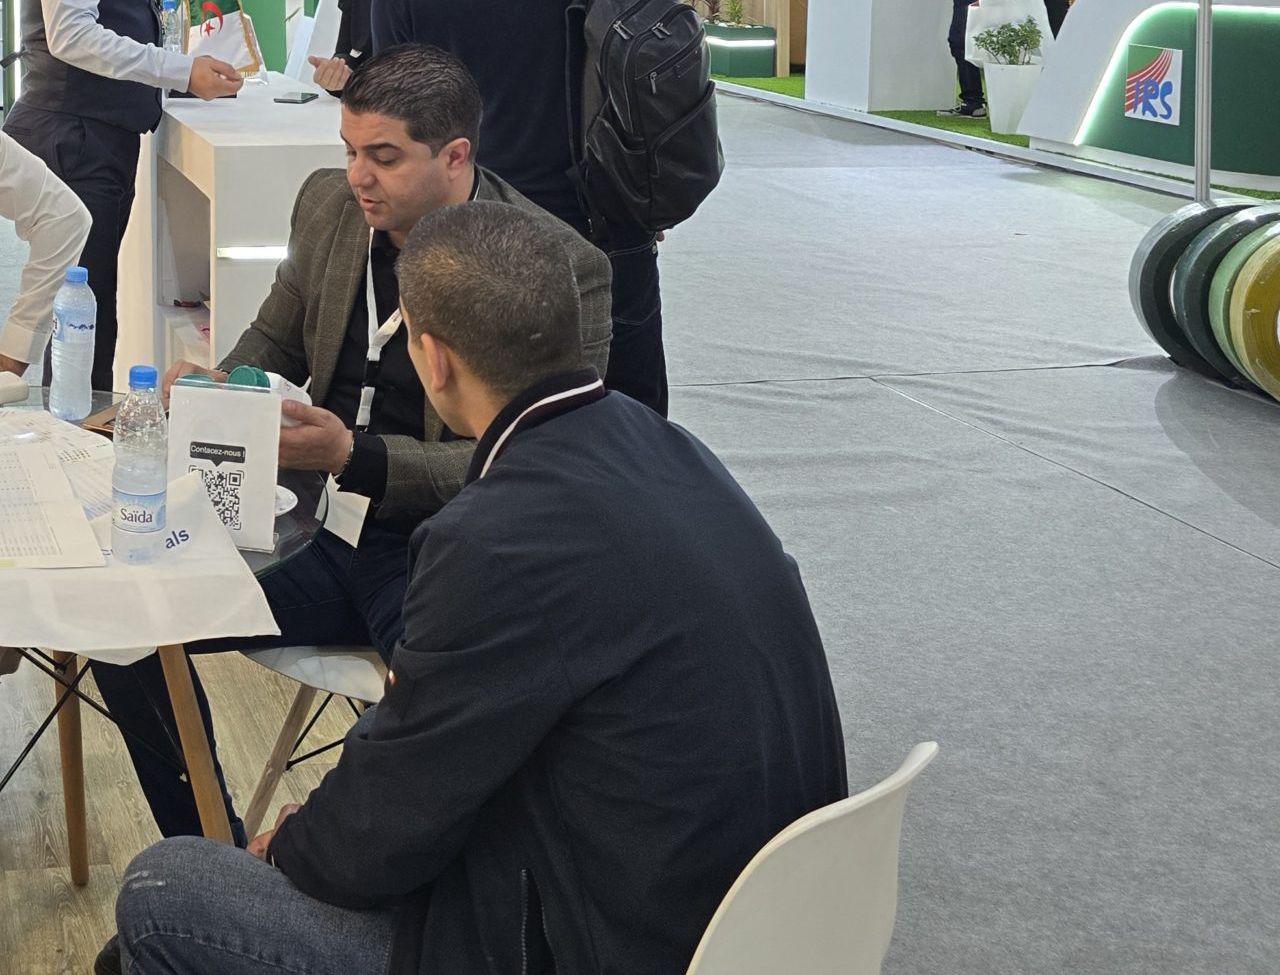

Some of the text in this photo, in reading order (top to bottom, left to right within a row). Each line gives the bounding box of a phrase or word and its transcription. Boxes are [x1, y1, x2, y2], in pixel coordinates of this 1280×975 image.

[1132, 77, 1173, 120] IRS
[120, 508, 153, 524] Saïda
[165, 528, 190, 549] als
